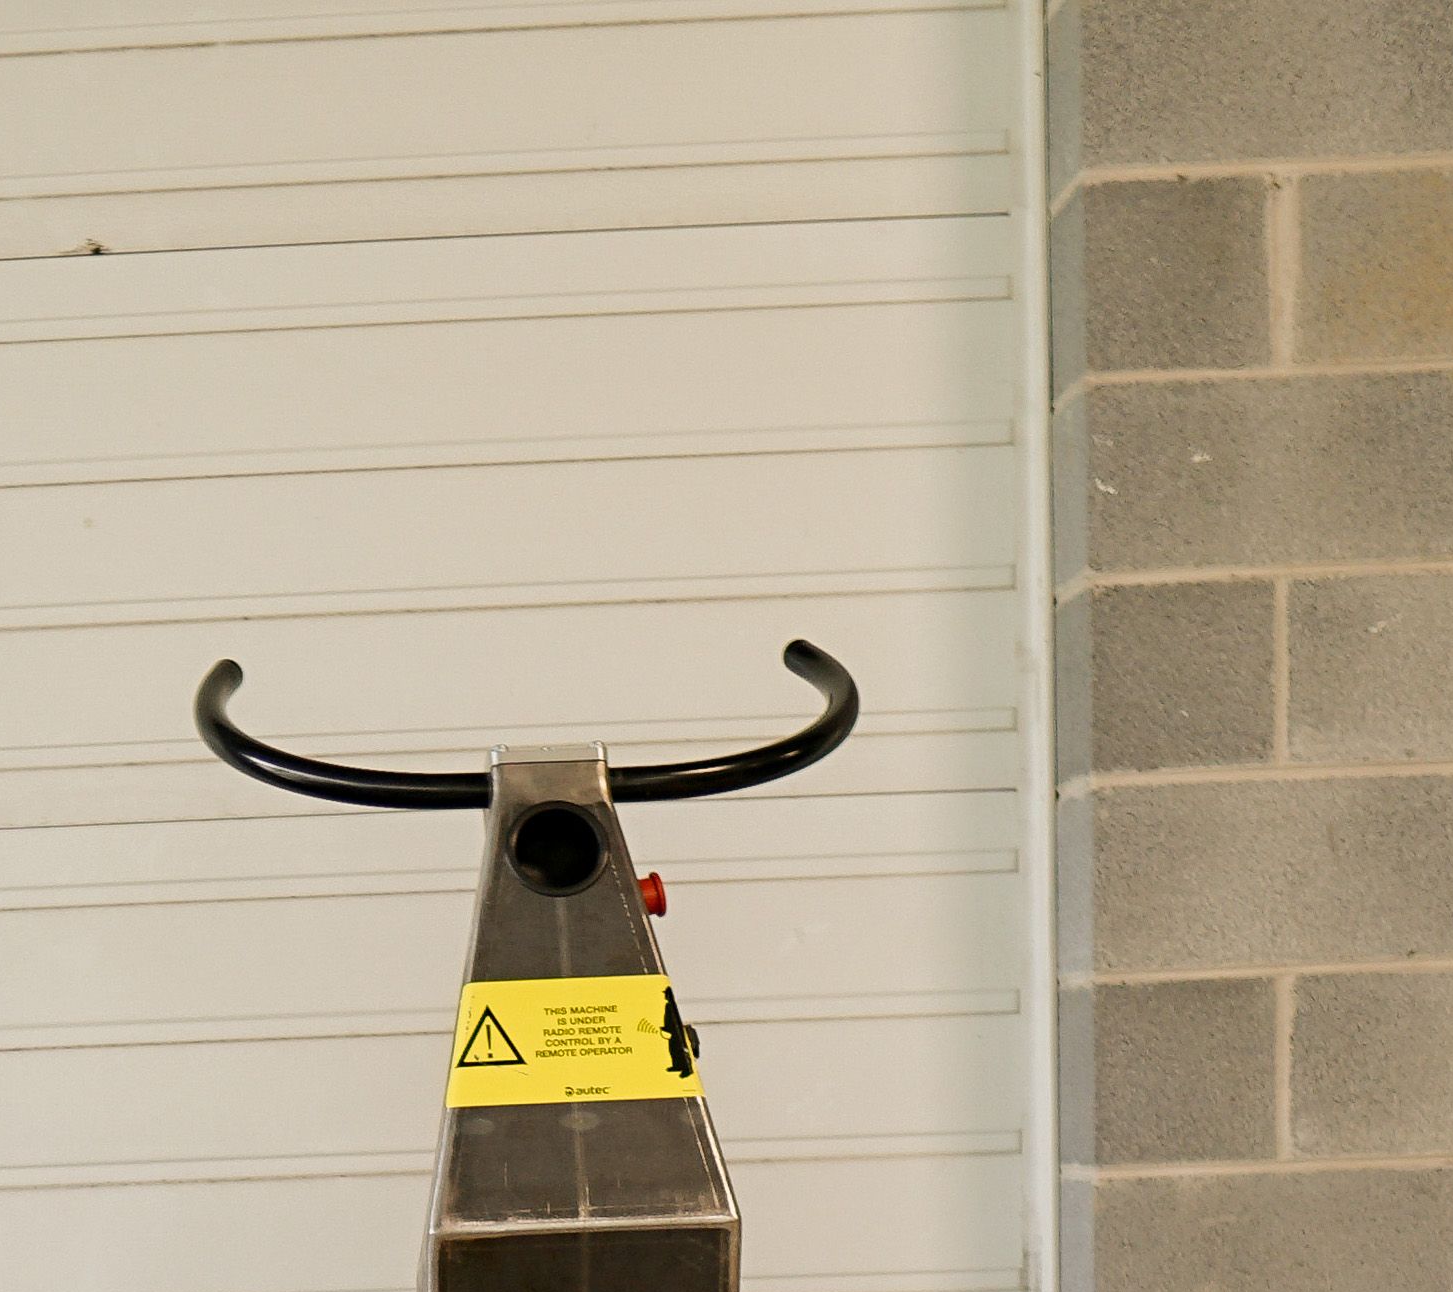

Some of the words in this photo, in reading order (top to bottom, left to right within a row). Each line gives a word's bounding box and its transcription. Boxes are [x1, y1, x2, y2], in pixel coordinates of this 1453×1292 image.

[544, 1007, 567, 1015] THIS
[570, 1005, 618, 1014] MACHINE
[569, 1016, 606, 1025] UNDER
[543, 1028, 576, 1036] RADIO
[578, 1026, 622, 1035] REMOTE
[545, 1037, 595, 1047] CONTROL
[598, 1037, 611, 1045] BY
[614, 1036, 622, 1044] A
[535, 1048, 577, 1058] REMOTE
[579, 1046, 633, 1056] OPERATOR
[575, 1086, 611, 1095] autec
